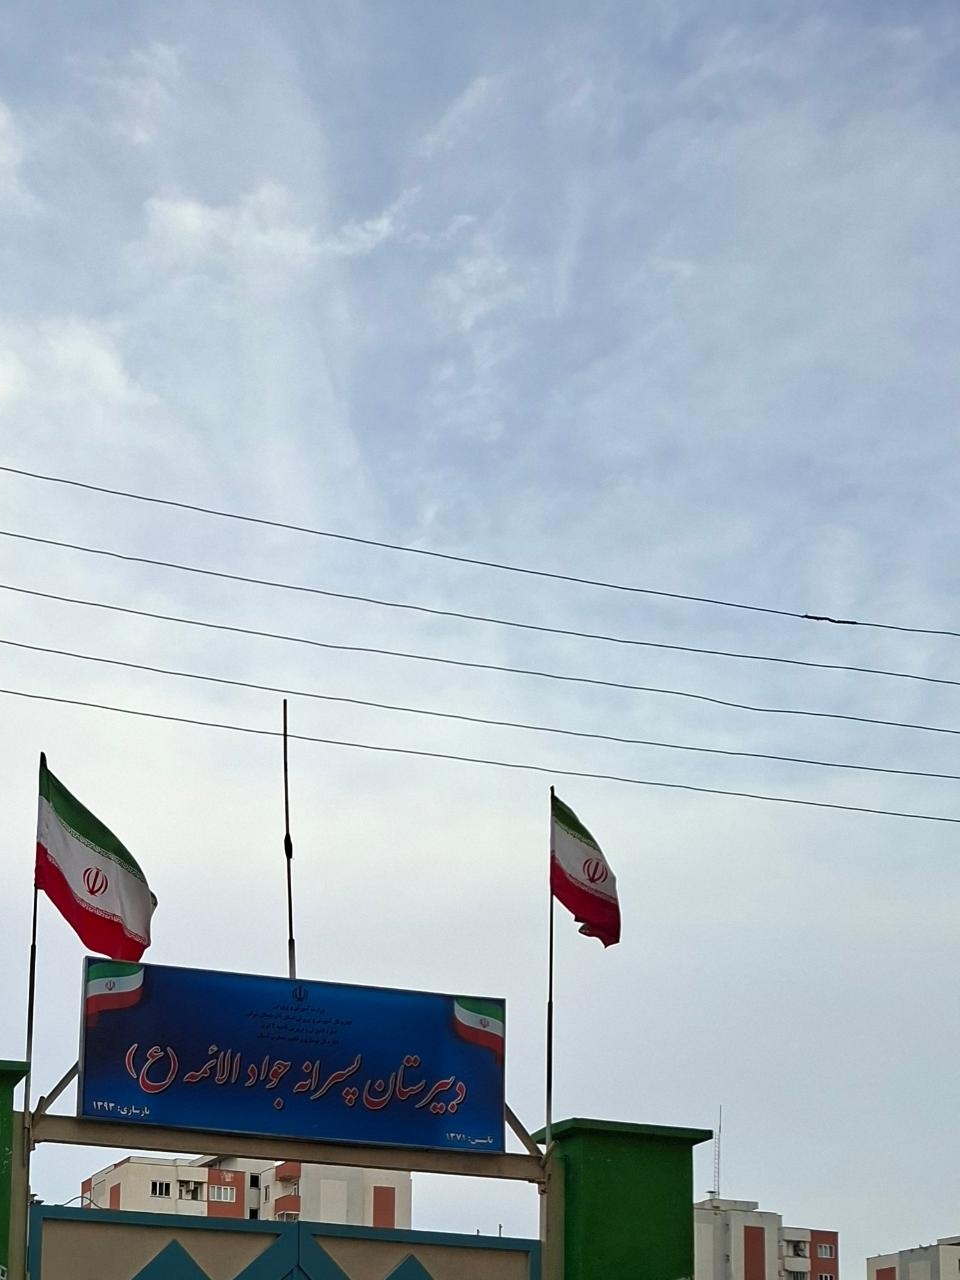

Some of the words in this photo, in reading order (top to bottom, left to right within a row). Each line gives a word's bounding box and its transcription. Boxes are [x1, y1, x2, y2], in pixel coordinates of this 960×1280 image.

[125, 1043, 178, 1093] (ع)
[244, 1055, 291, 1110] جواد
[292, 1054, 362, 1106] پسرانه
[363, 1055, 466, 1114] دبیرستان
